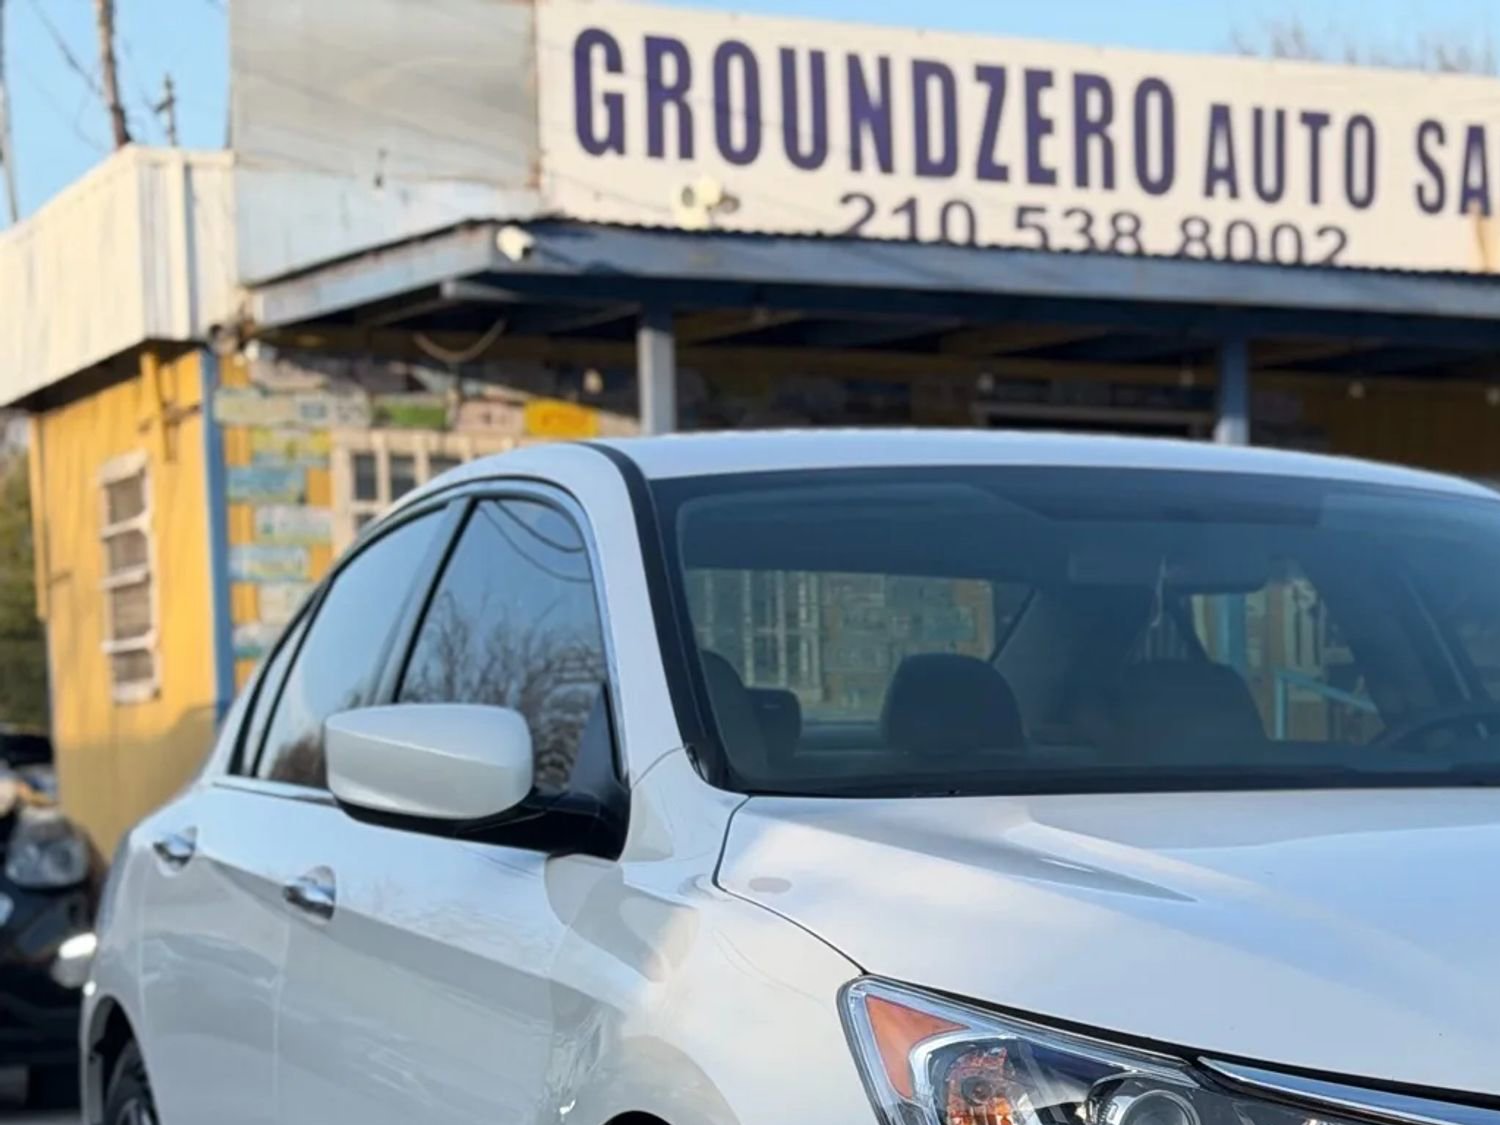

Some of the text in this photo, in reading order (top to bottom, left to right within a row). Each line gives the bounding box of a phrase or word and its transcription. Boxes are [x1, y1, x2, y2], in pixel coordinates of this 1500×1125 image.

[573, 27, 1177, 196] GROUNDZERO
[1204, 103, 1377, 210] AUTO
[840, 192, 1348, 265] 210 538 8002
